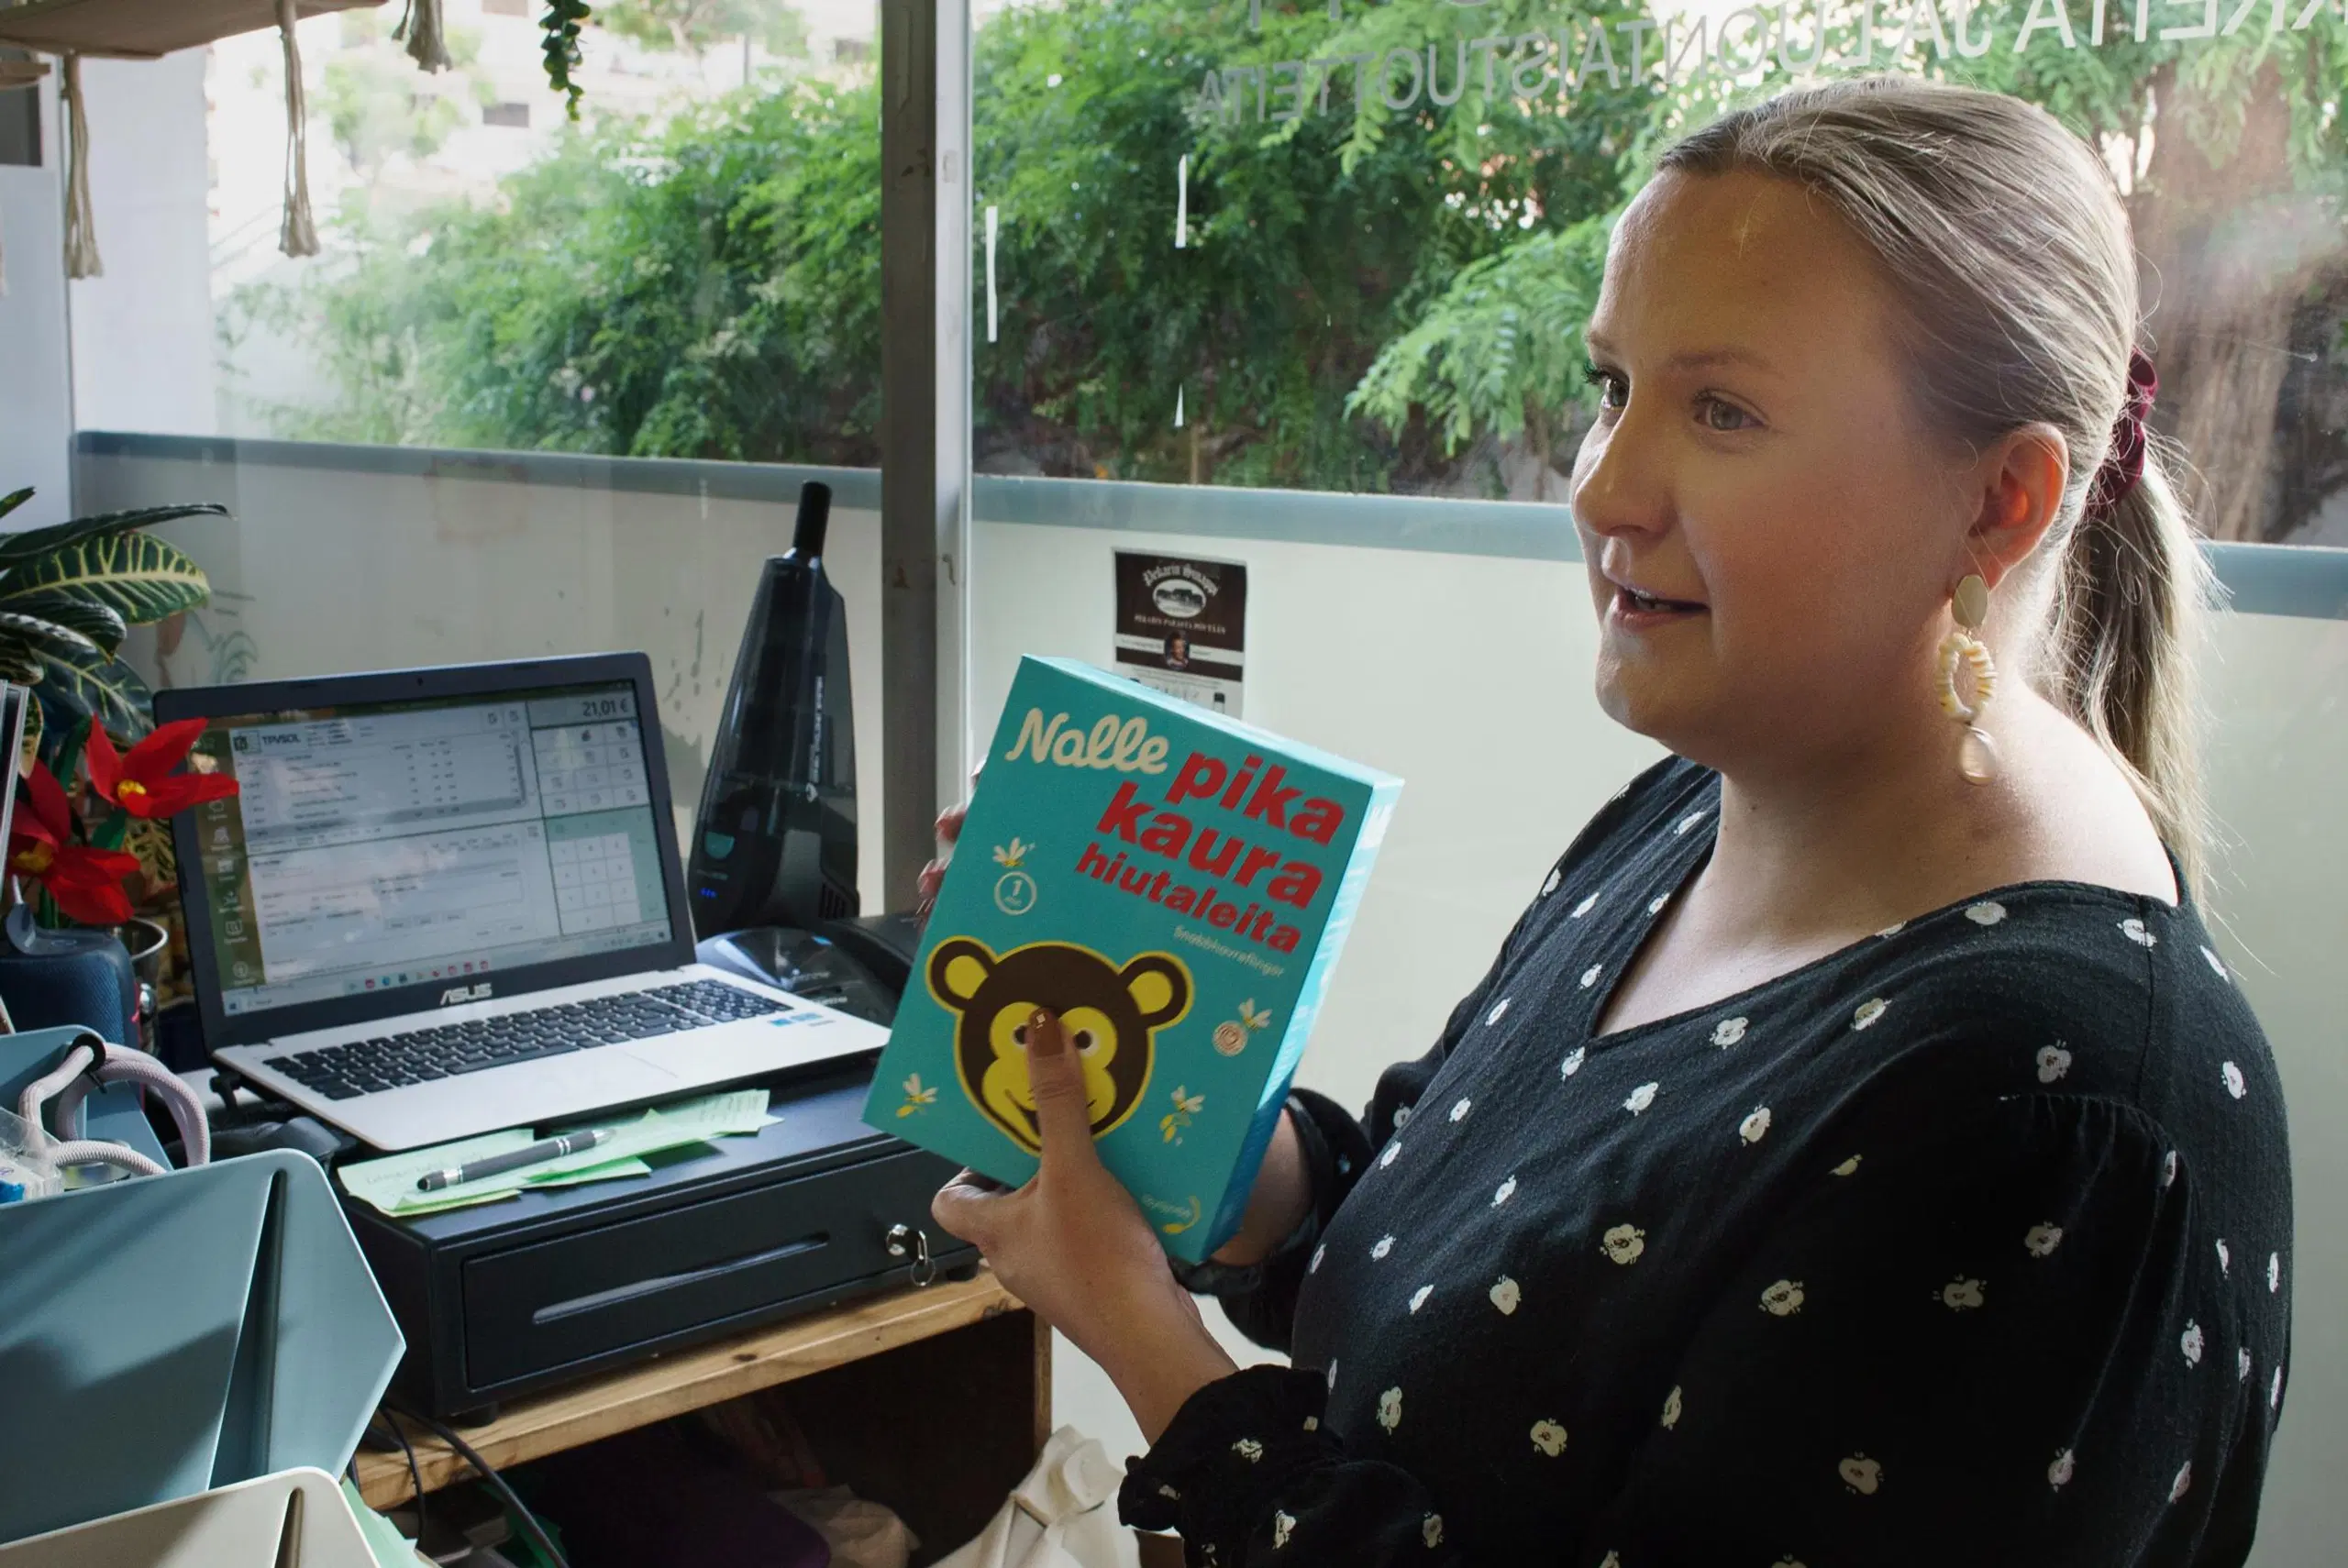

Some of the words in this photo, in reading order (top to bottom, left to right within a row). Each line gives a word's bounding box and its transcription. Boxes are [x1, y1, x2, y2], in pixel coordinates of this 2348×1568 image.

[582, 700, 616, 717] 21,01
[1005, 707, 1171, 776] Nalle
[1164, 751, 1347, 847] pika
[1096, 780, 1325, 911] kaura
[1075, 842, 1302, 955] hiutaleita
[440, 983, 493, 1007] ASUS
